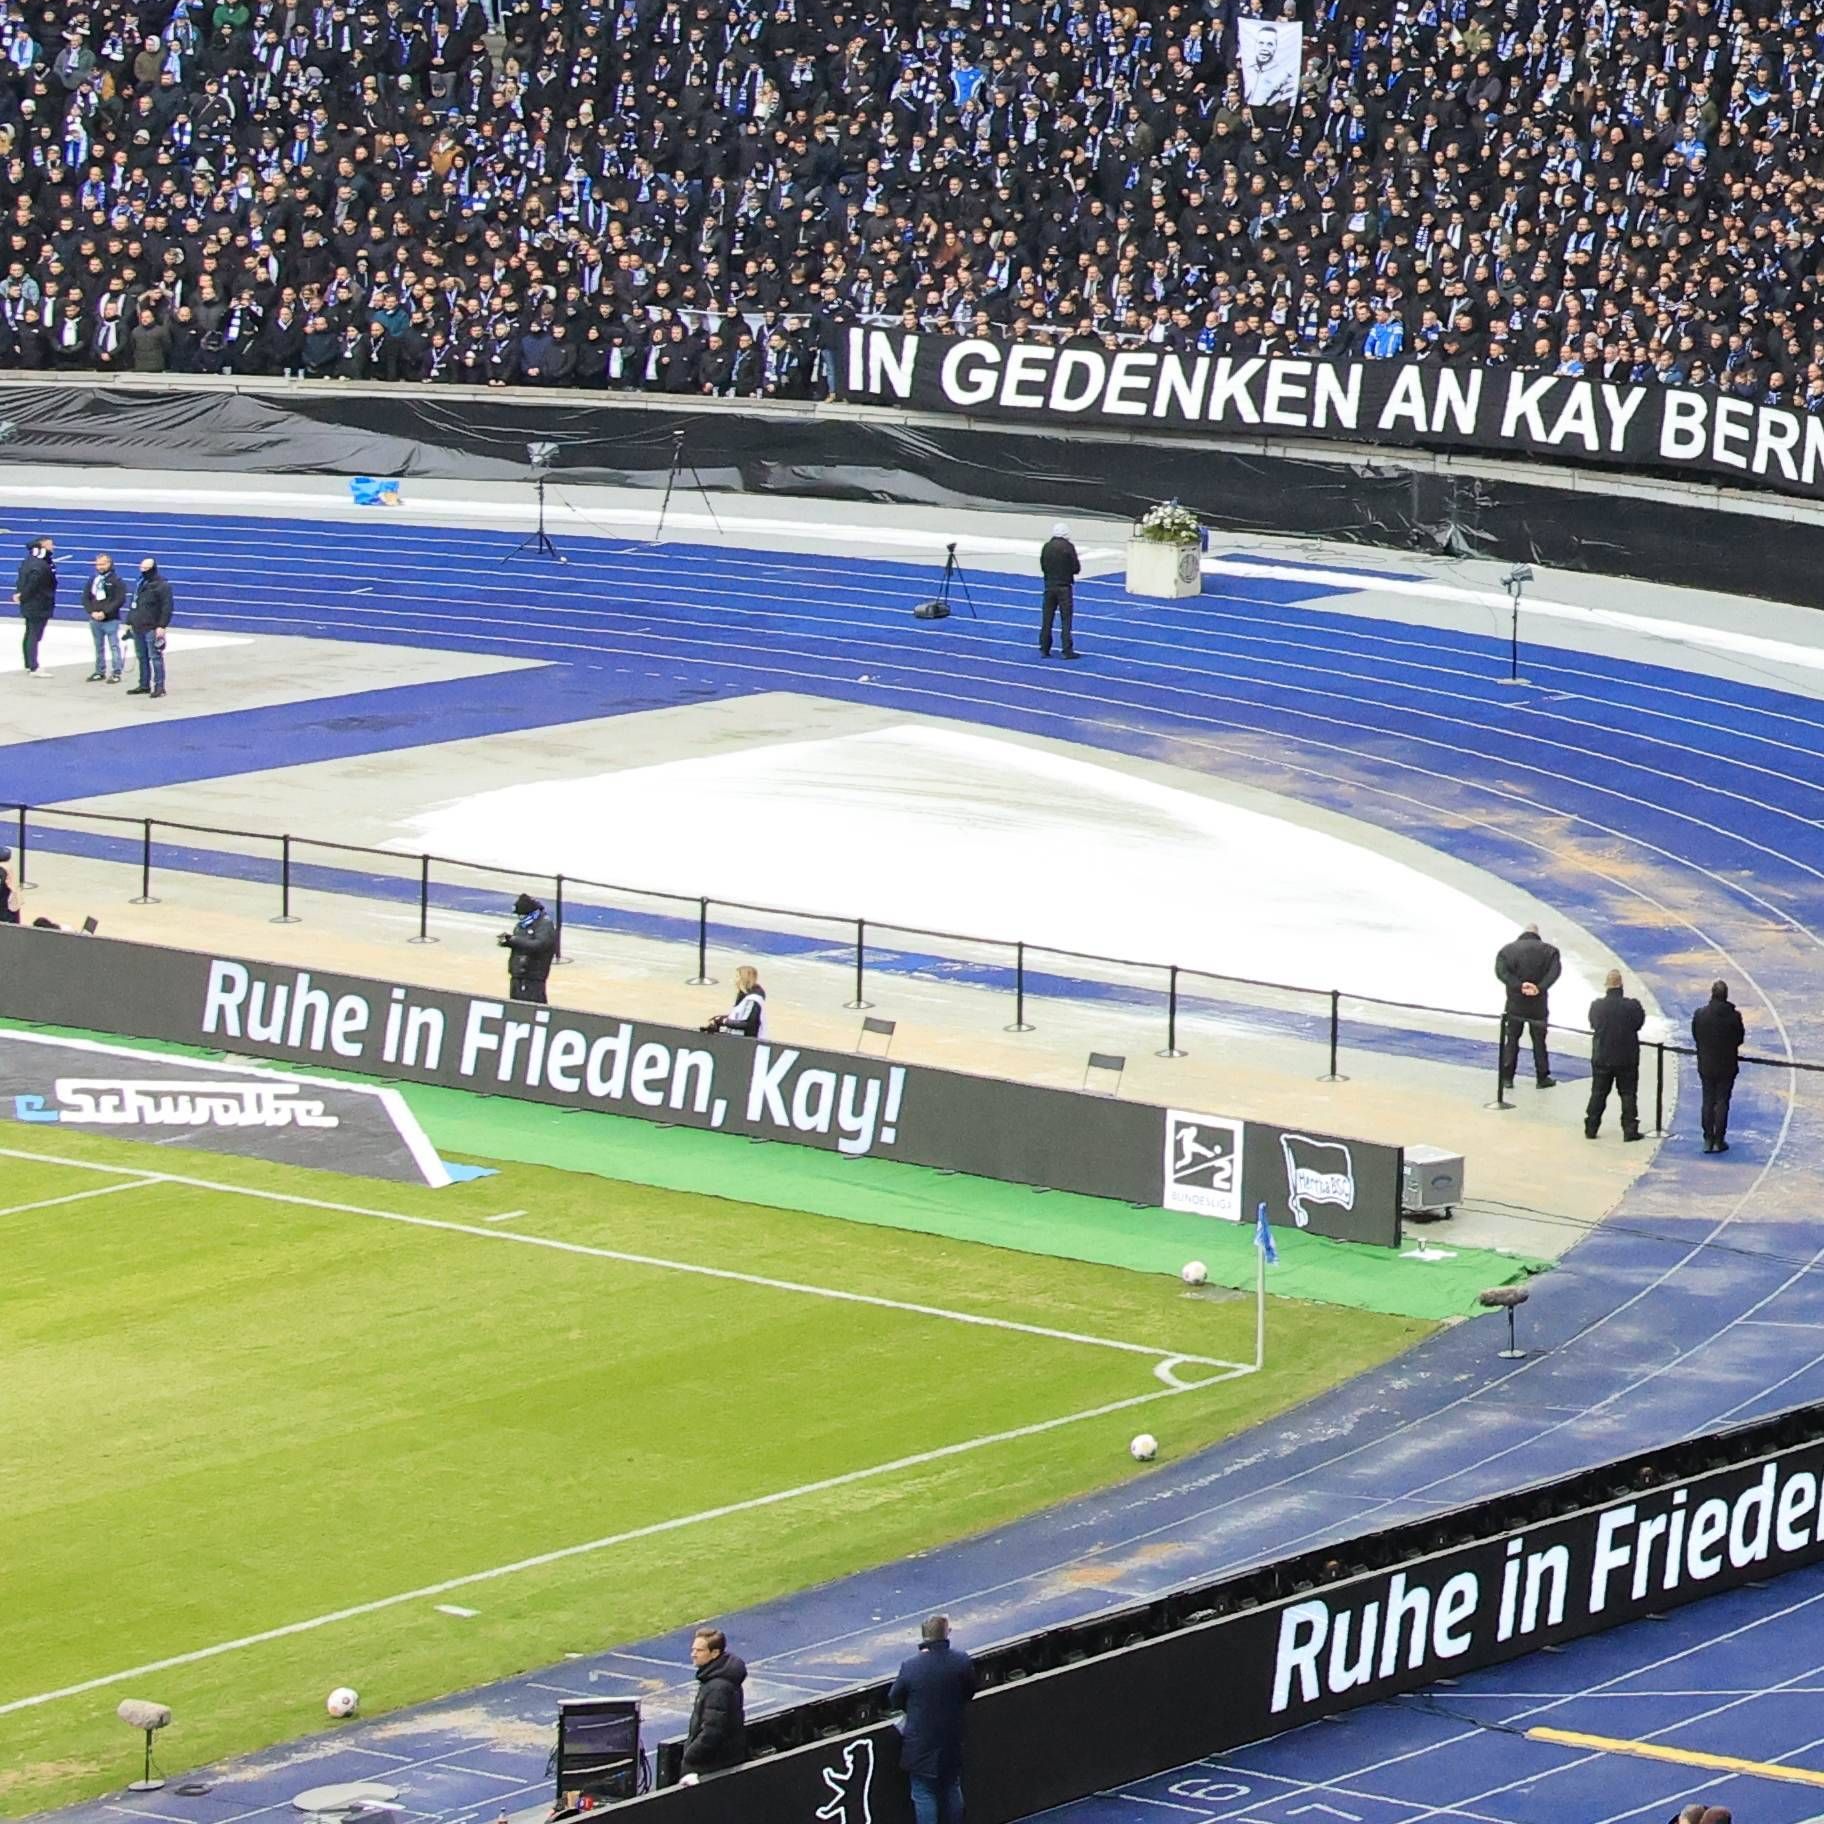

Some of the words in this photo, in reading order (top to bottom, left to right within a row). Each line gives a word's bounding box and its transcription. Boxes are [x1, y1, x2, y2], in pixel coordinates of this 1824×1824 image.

[847, 326, 919, 399] IN
[940, 340, 1362, 432] GEDENKEN
[1377, 364, 1484, 437] AN
[1500, 371, 1647, 453] KAY
[202, 959, 370, 1058] Ruhe
[382, 987, 445, 1070] in
[460, 999, 728, 1127] Frieden,
[746, 1044, 906, 1155] Kay!
[1171, 1191, 1232, 1210] BUNDESLIGA
[1269, 1571, 1479, 1714] Ruhe
[1497, 1537, 1569, 1642] in
